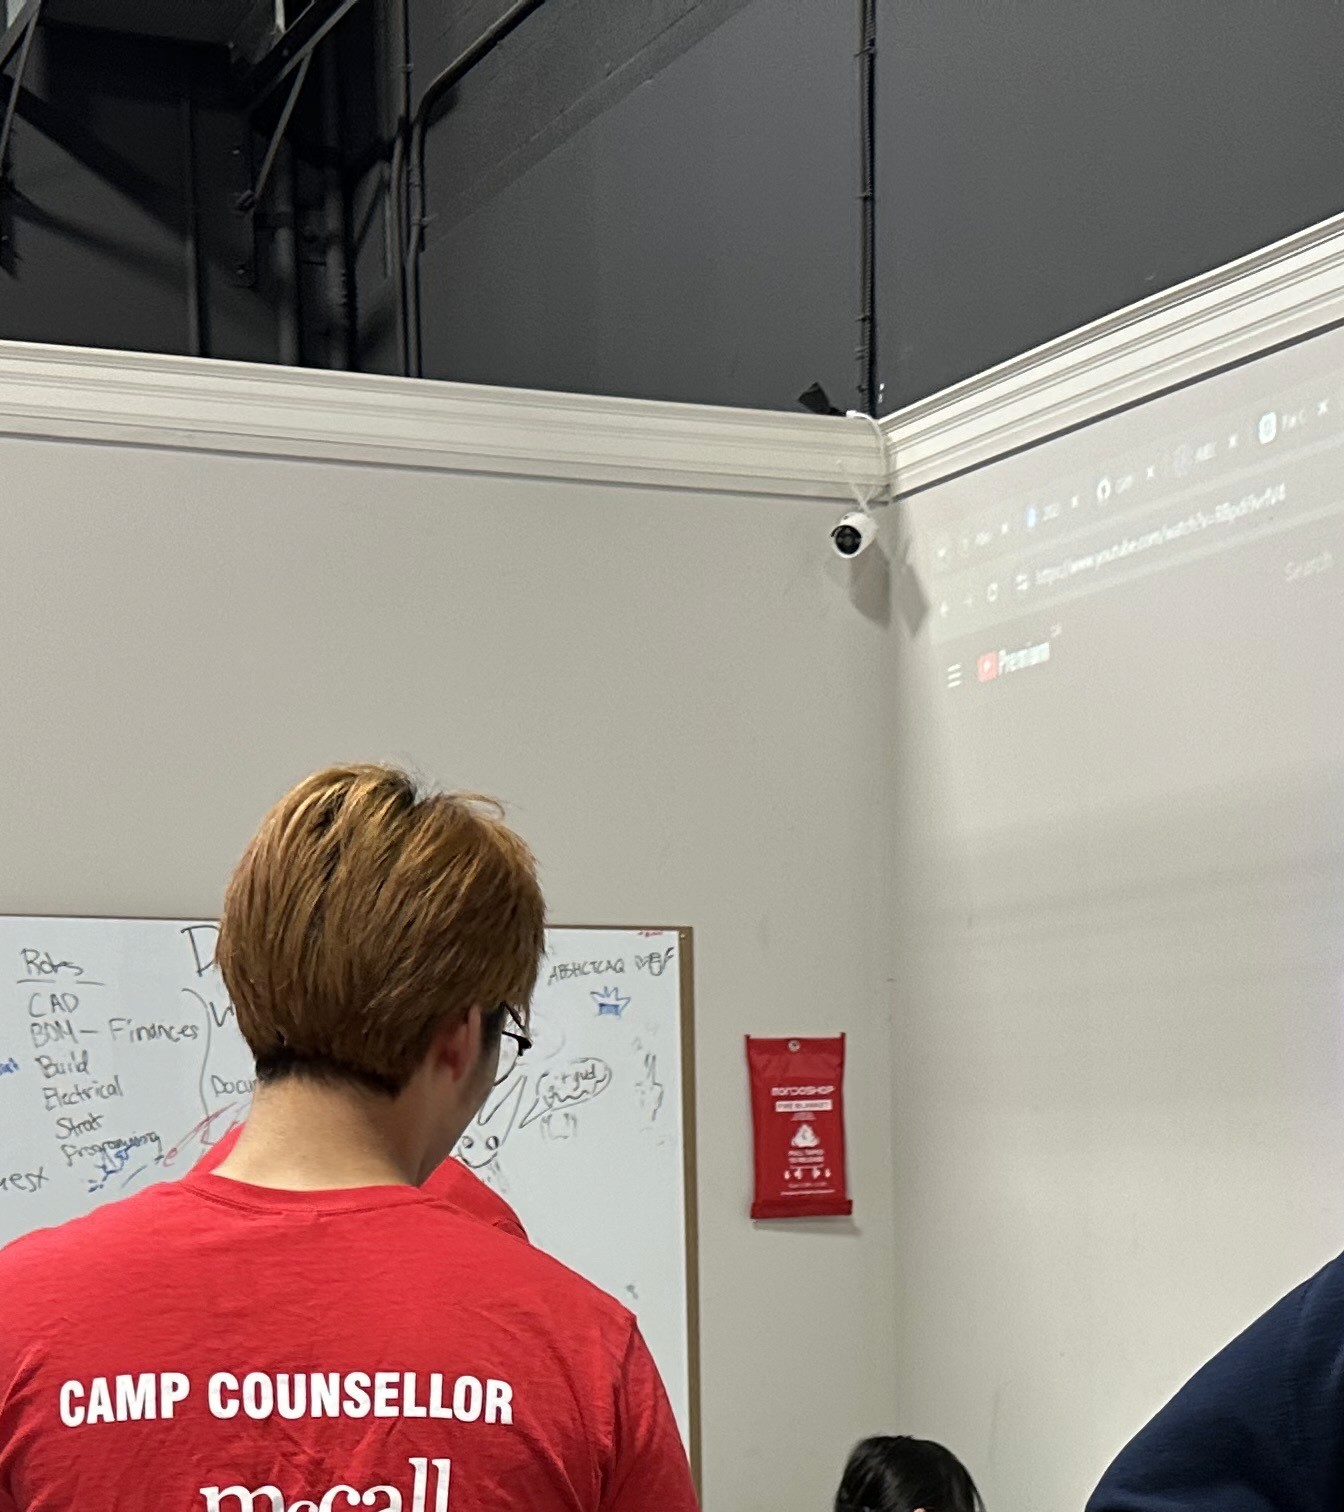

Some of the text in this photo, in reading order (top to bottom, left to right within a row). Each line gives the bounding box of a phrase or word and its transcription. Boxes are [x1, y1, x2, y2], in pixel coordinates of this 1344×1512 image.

[28, 992, 79, 1018] CAD
[108, 1017, 199, 1044] Finances
[35, 1049, 90, 1079] Build
[42, 1075, 124, 1111] Electrical
[59, 1371, 514, 1427] CAMP COUNSELLOR
